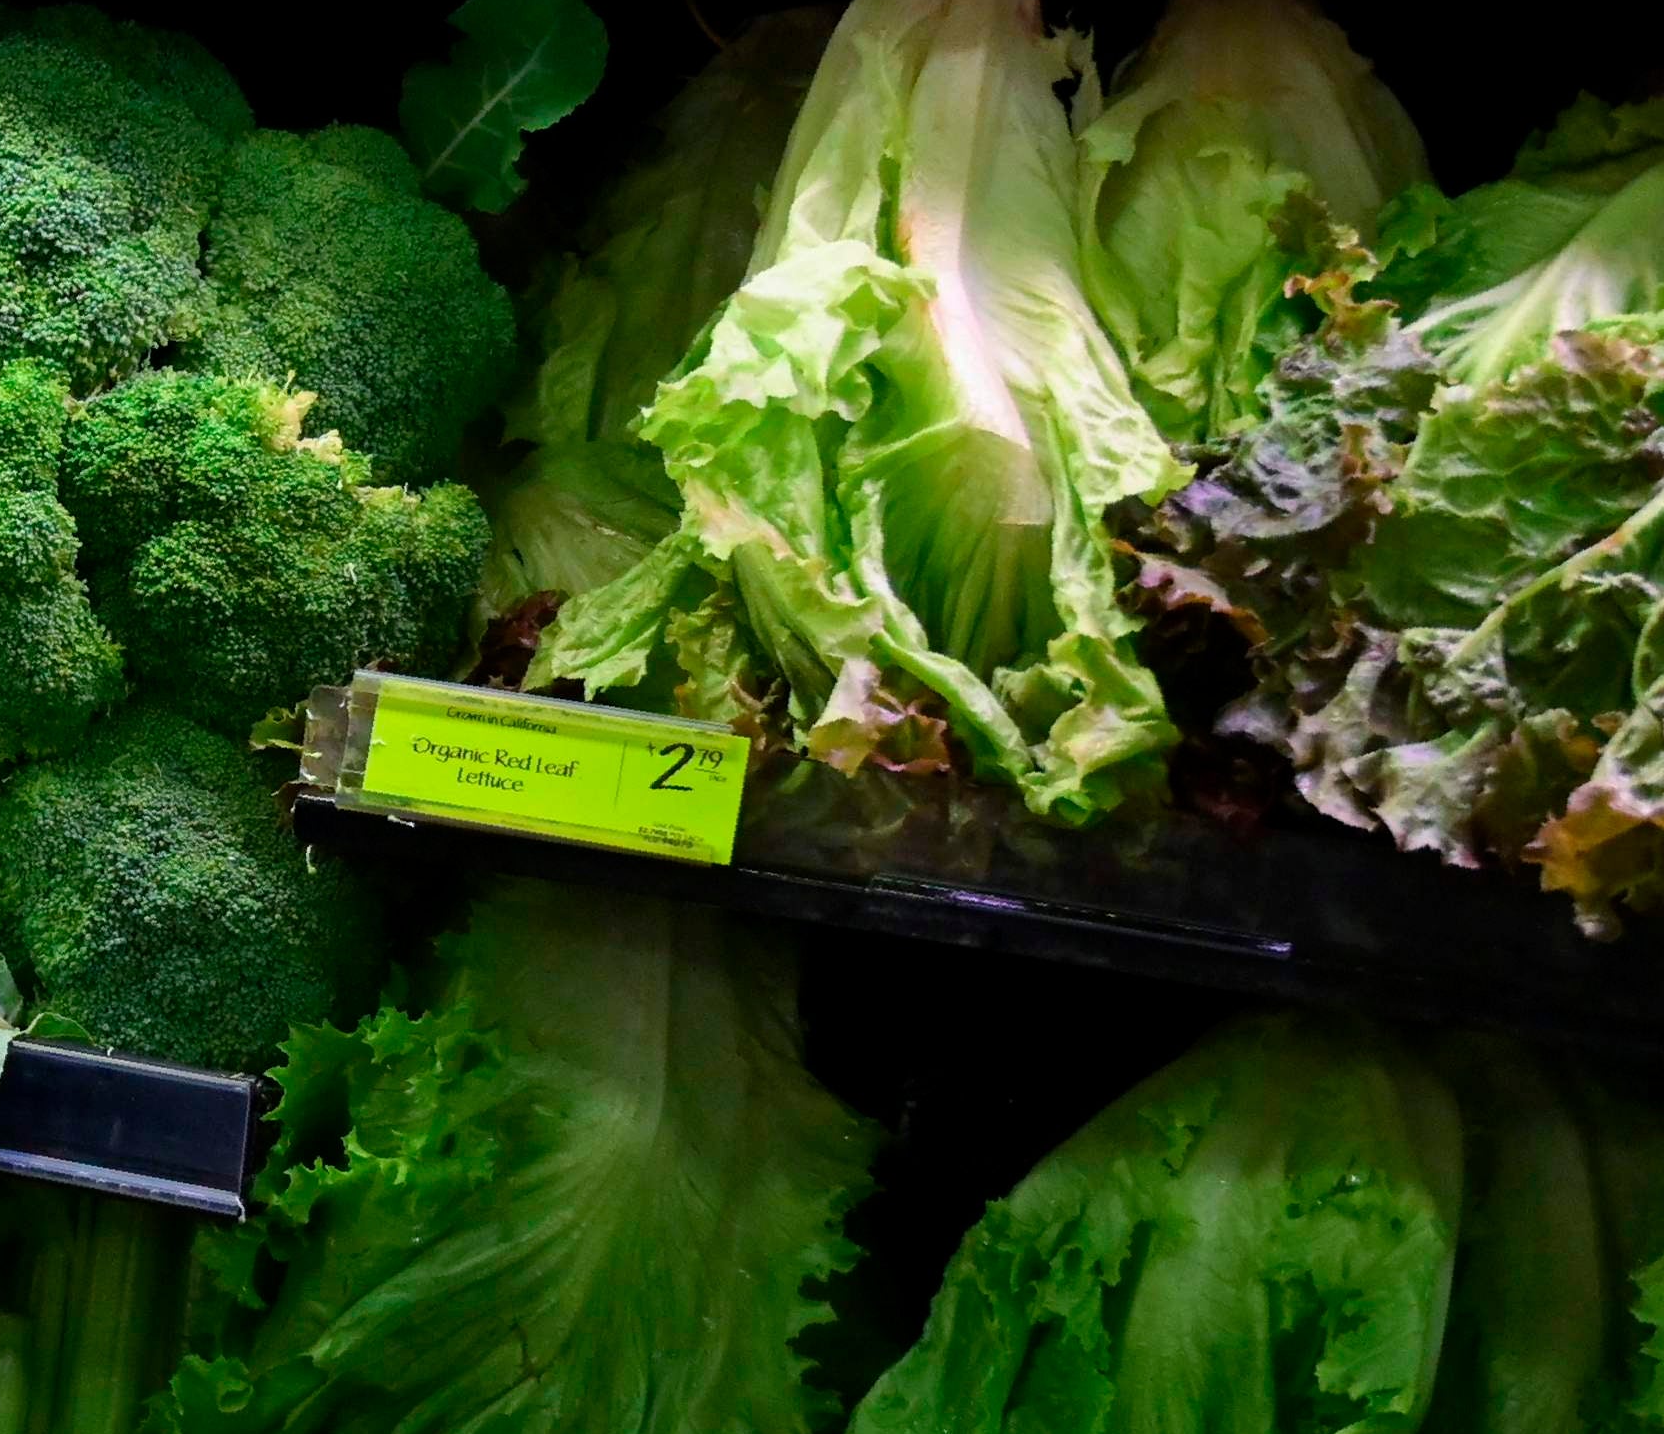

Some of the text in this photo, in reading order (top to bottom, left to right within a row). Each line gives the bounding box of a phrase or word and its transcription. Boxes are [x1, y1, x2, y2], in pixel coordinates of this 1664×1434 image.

[446, 705, 486, 723] Grown
[500, 715, 557, 735] California
[413, 736, 580, 778] Organic Red Leaf
[456, 767, 525, 793] Lettuce
